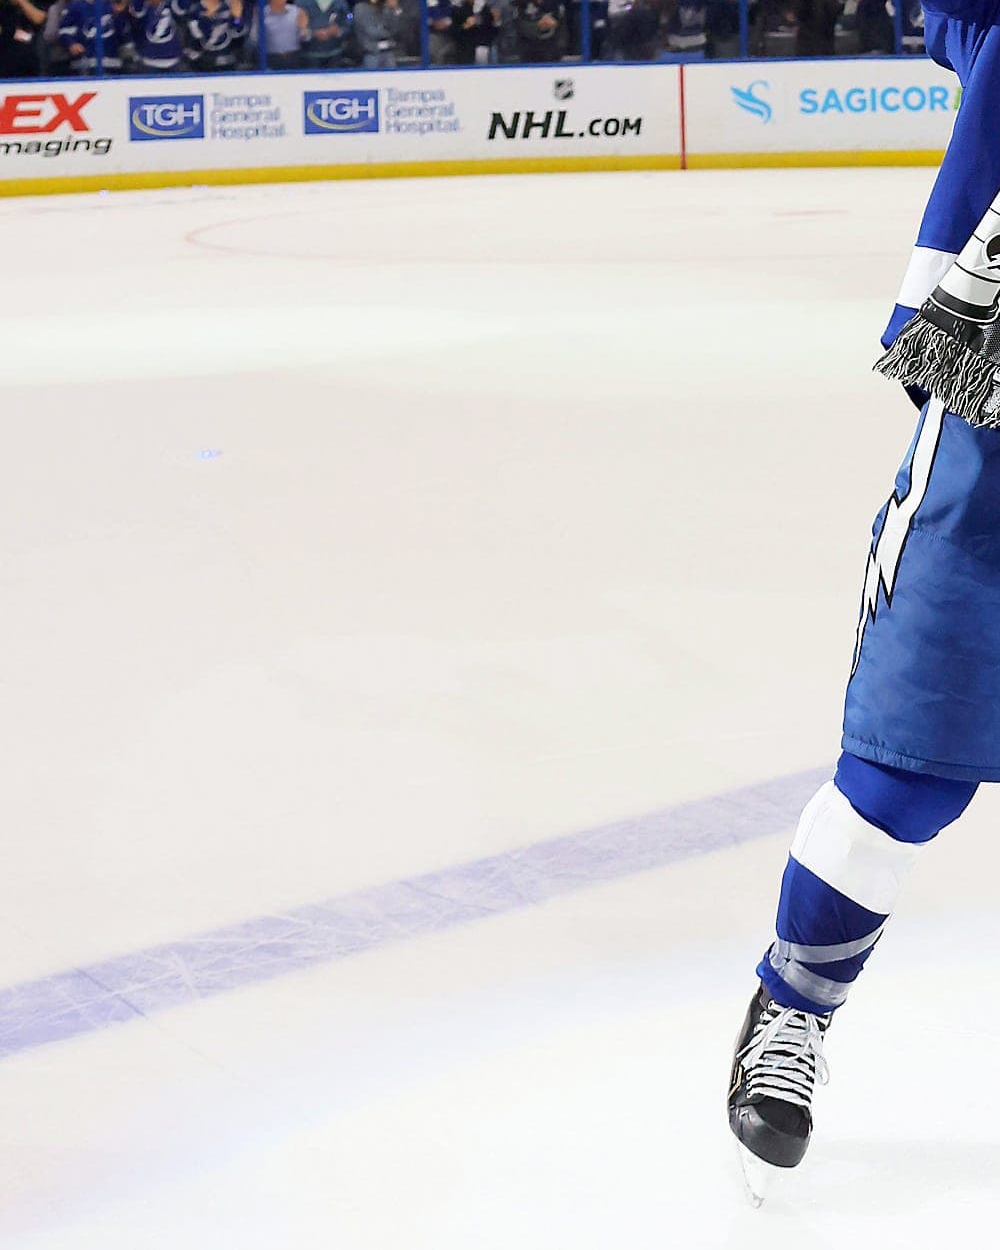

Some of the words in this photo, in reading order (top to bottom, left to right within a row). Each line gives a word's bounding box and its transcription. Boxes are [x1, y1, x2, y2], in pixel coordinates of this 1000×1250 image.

[211, 93, 271, 108] Tampa
[387, 88, 446, 103] Tampa
[799, 86, 950, 113] SAGICOR
[0, 92, 98, 135] EX
[142, 103, 201, 127] TGH
[211, 107, 281, 123] General
[316, 97, 376, 121] TGH
[386, 102, 456, 118] General
[211, 122, 286, 140] Hospital
[386, 117, 460, 136] Hospital
